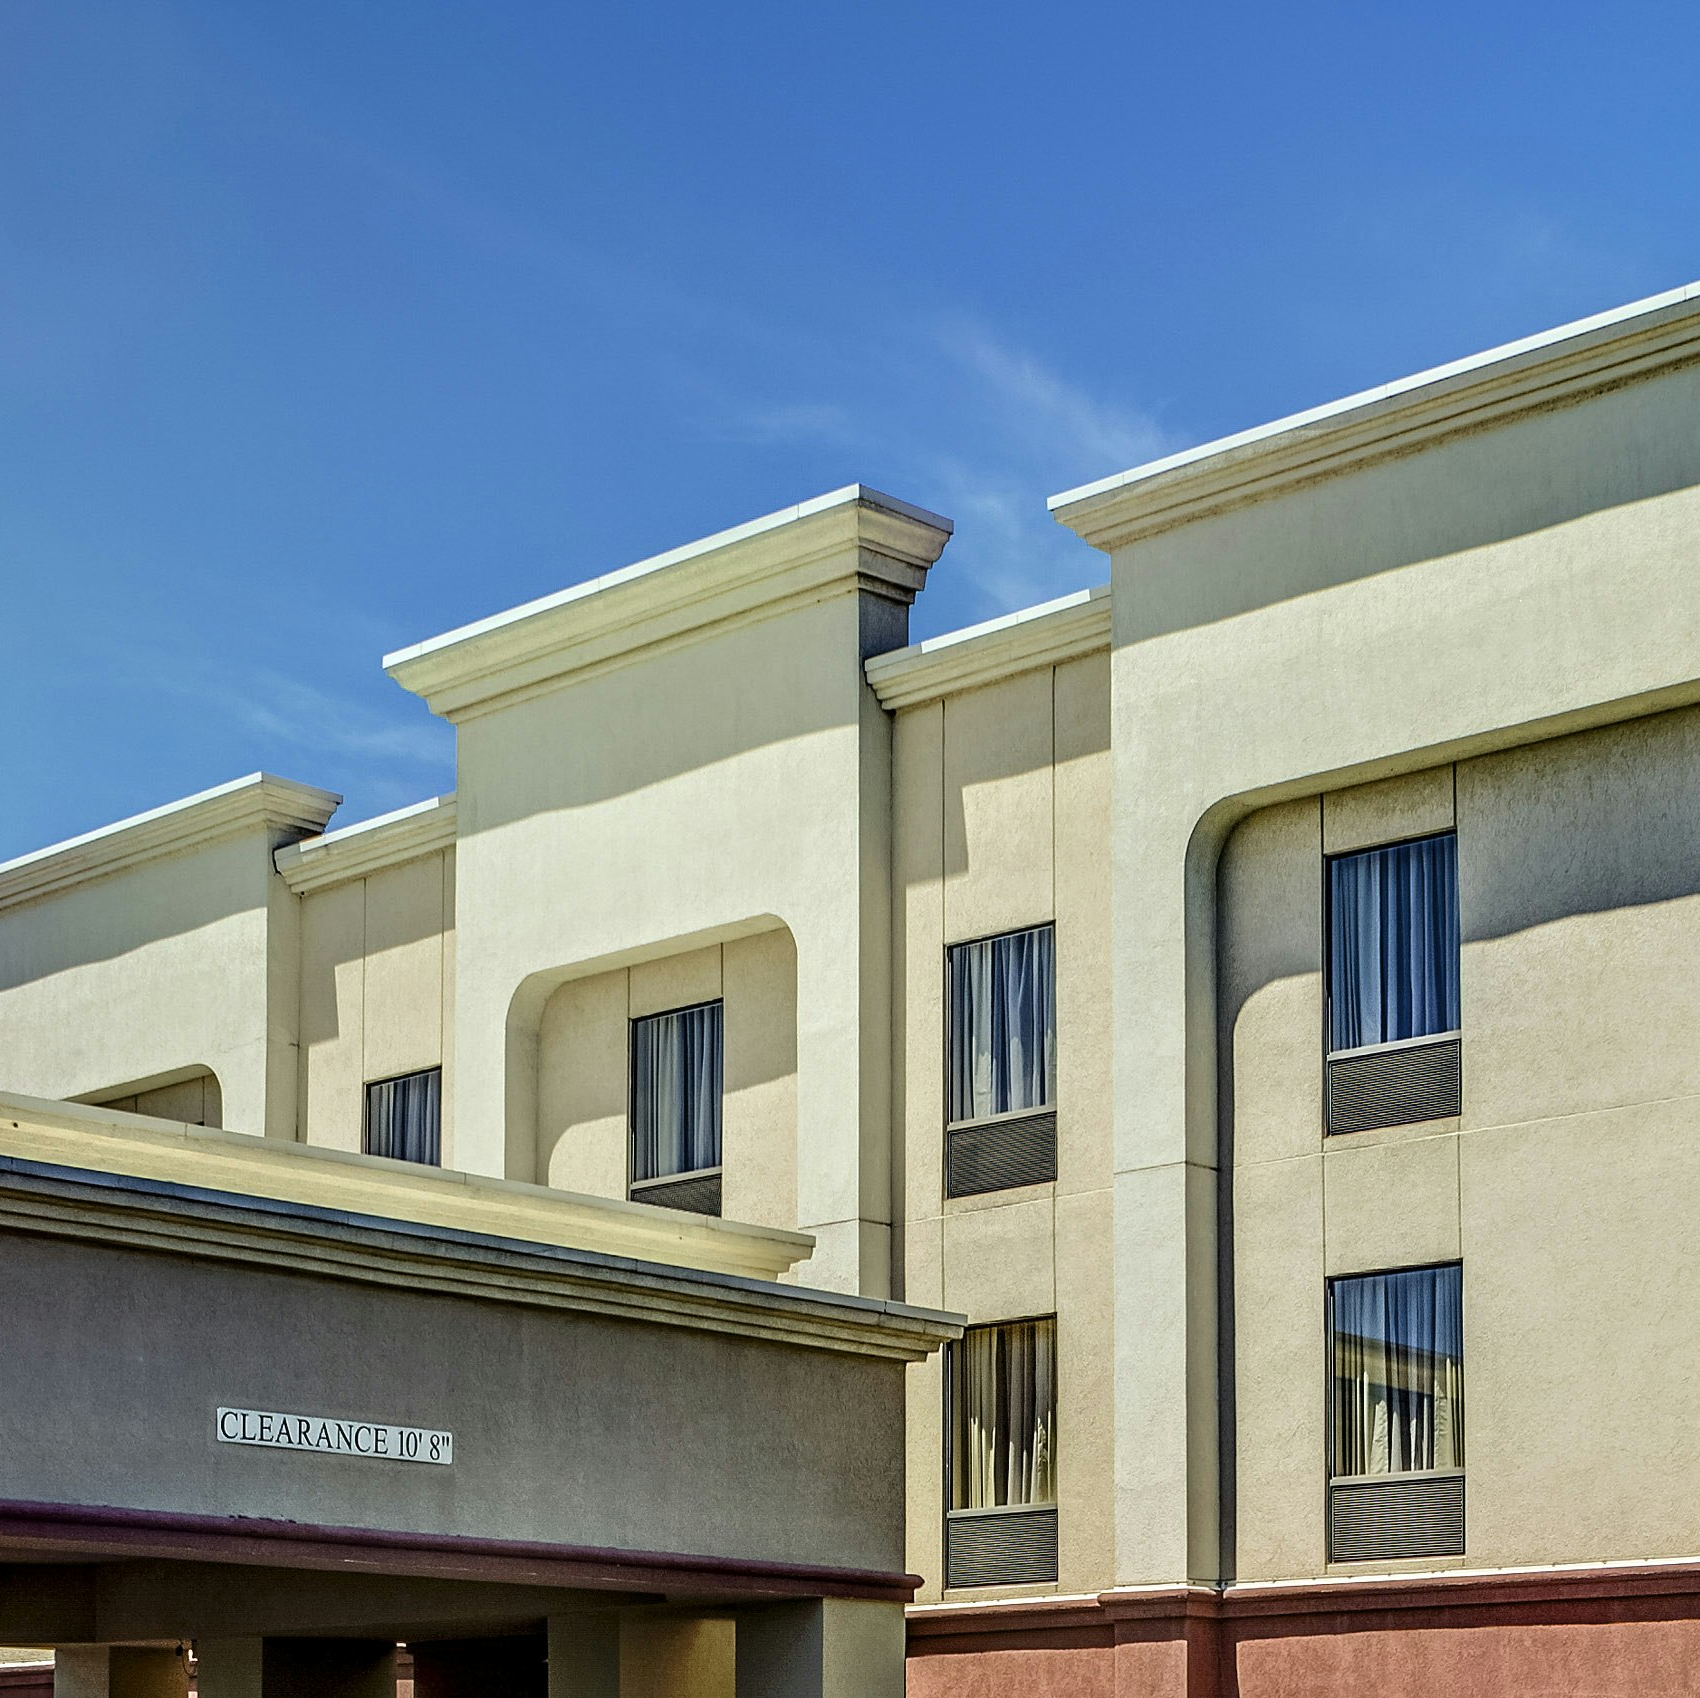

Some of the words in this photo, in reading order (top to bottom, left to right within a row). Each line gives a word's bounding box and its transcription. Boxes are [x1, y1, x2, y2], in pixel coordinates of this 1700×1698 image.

[220, 1411, 388, 1454] CLEARANCE
[397, 1430, 422, 1457] 10'
[429, 1434, 450, 1460] 8"
